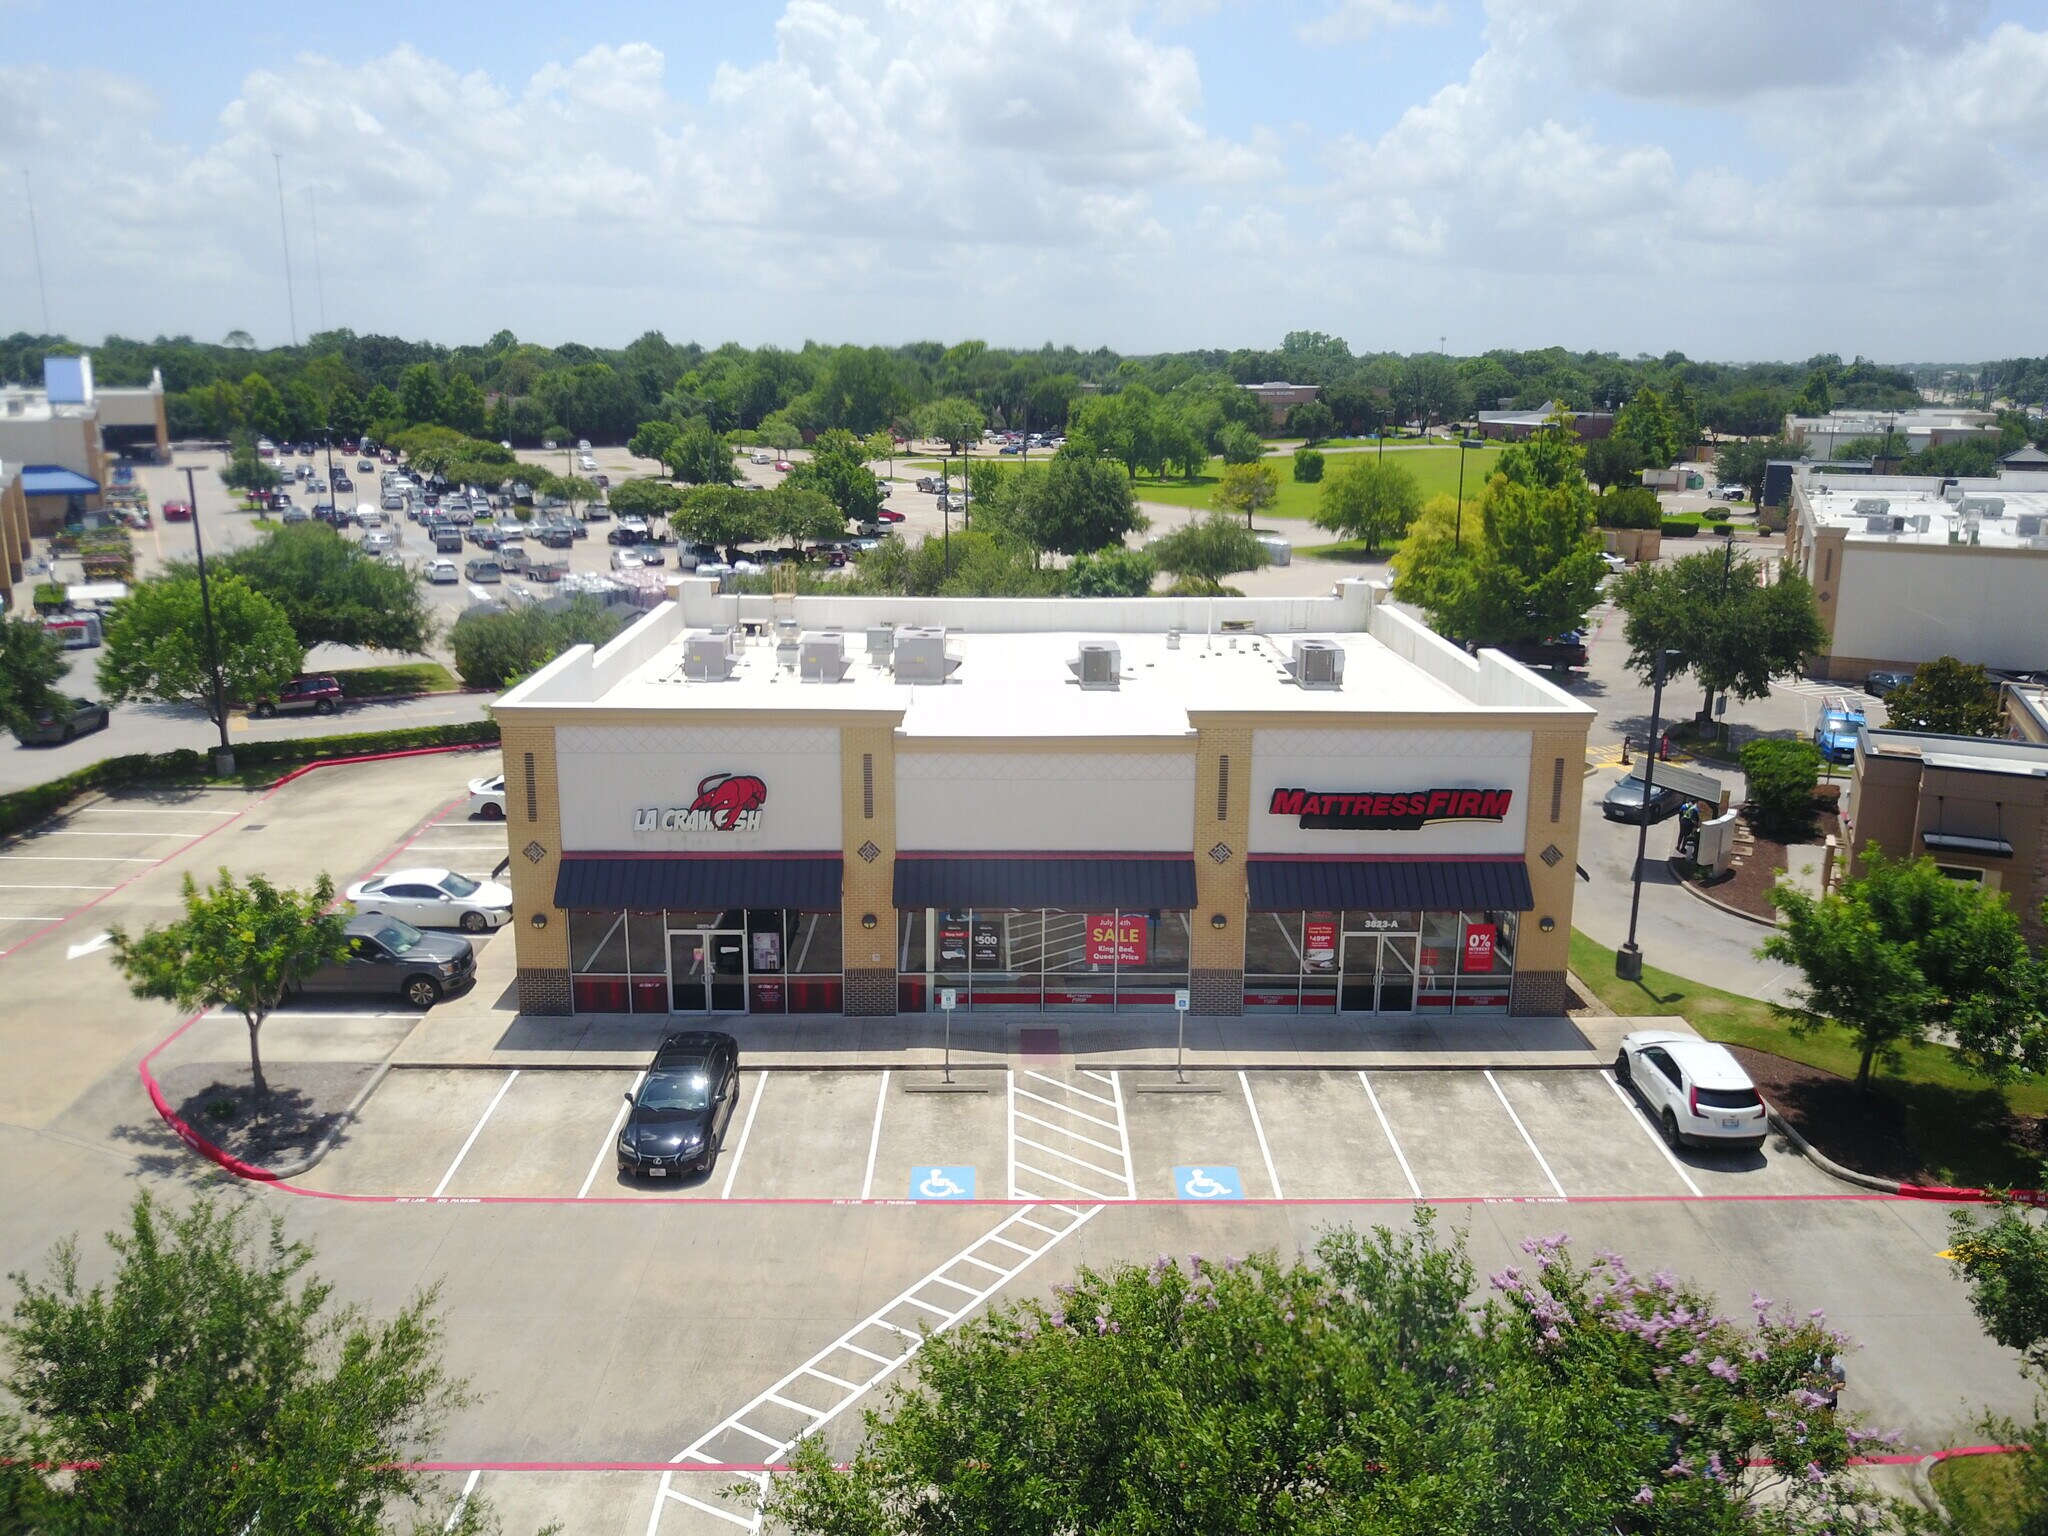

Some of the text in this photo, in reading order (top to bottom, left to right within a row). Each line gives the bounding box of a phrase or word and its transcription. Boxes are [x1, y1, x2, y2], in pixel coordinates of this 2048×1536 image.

[634, 808, 762, 832] LA CRAWFSH
[1099, 919, 1114, 927] July
[1364, 920, 1399, 928] 3823-A
[1092, 927, 1140, 943] SALE
[975, 935, 998, 945] $500
[1468, 934, 1491, 947] 0%
[1098, 945, 1115, 954] King
[1093, 953, 1140, 961] Queen Price
